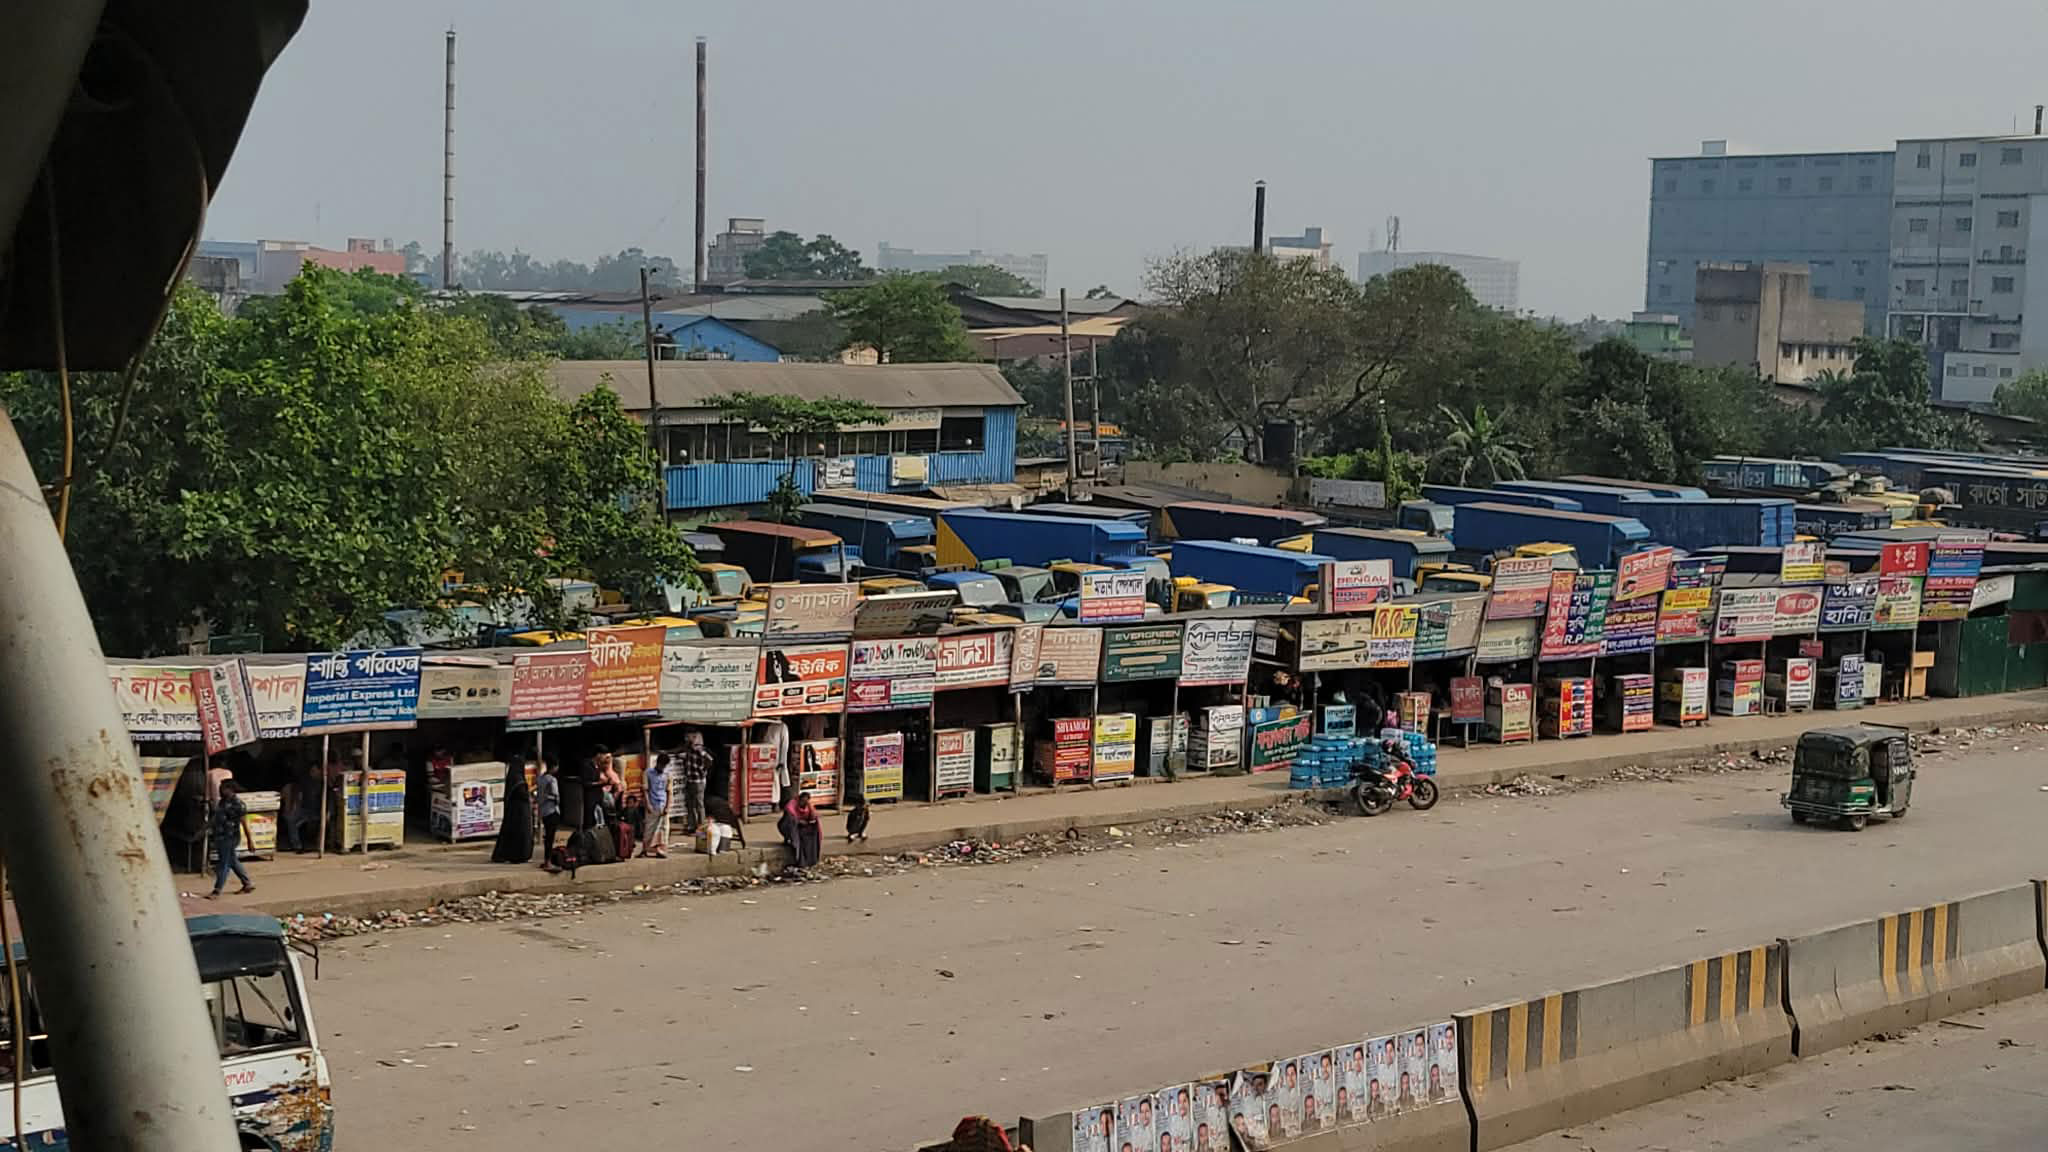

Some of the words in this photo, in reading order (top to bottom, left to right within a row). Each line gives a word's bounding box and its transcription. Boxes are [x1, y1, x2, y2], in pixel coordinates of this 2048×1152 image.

[2016, 483, 2048, 509] সার্ভি
[1187, 630, 1254, 642] MARSA
[309, 653, 351, 680] শান্তি
[355, 651, 420, 677] পরিবহন
[788, 657, 840, 676] ইউনিক
[130, 671, 194, 704] লাইন
[306, 690, 350, 704] Imperial
[352, 689, 395, 702] Express
[398, 687, 418, 698] Ltd.
[224, 1070, 255, 1087] ervice
